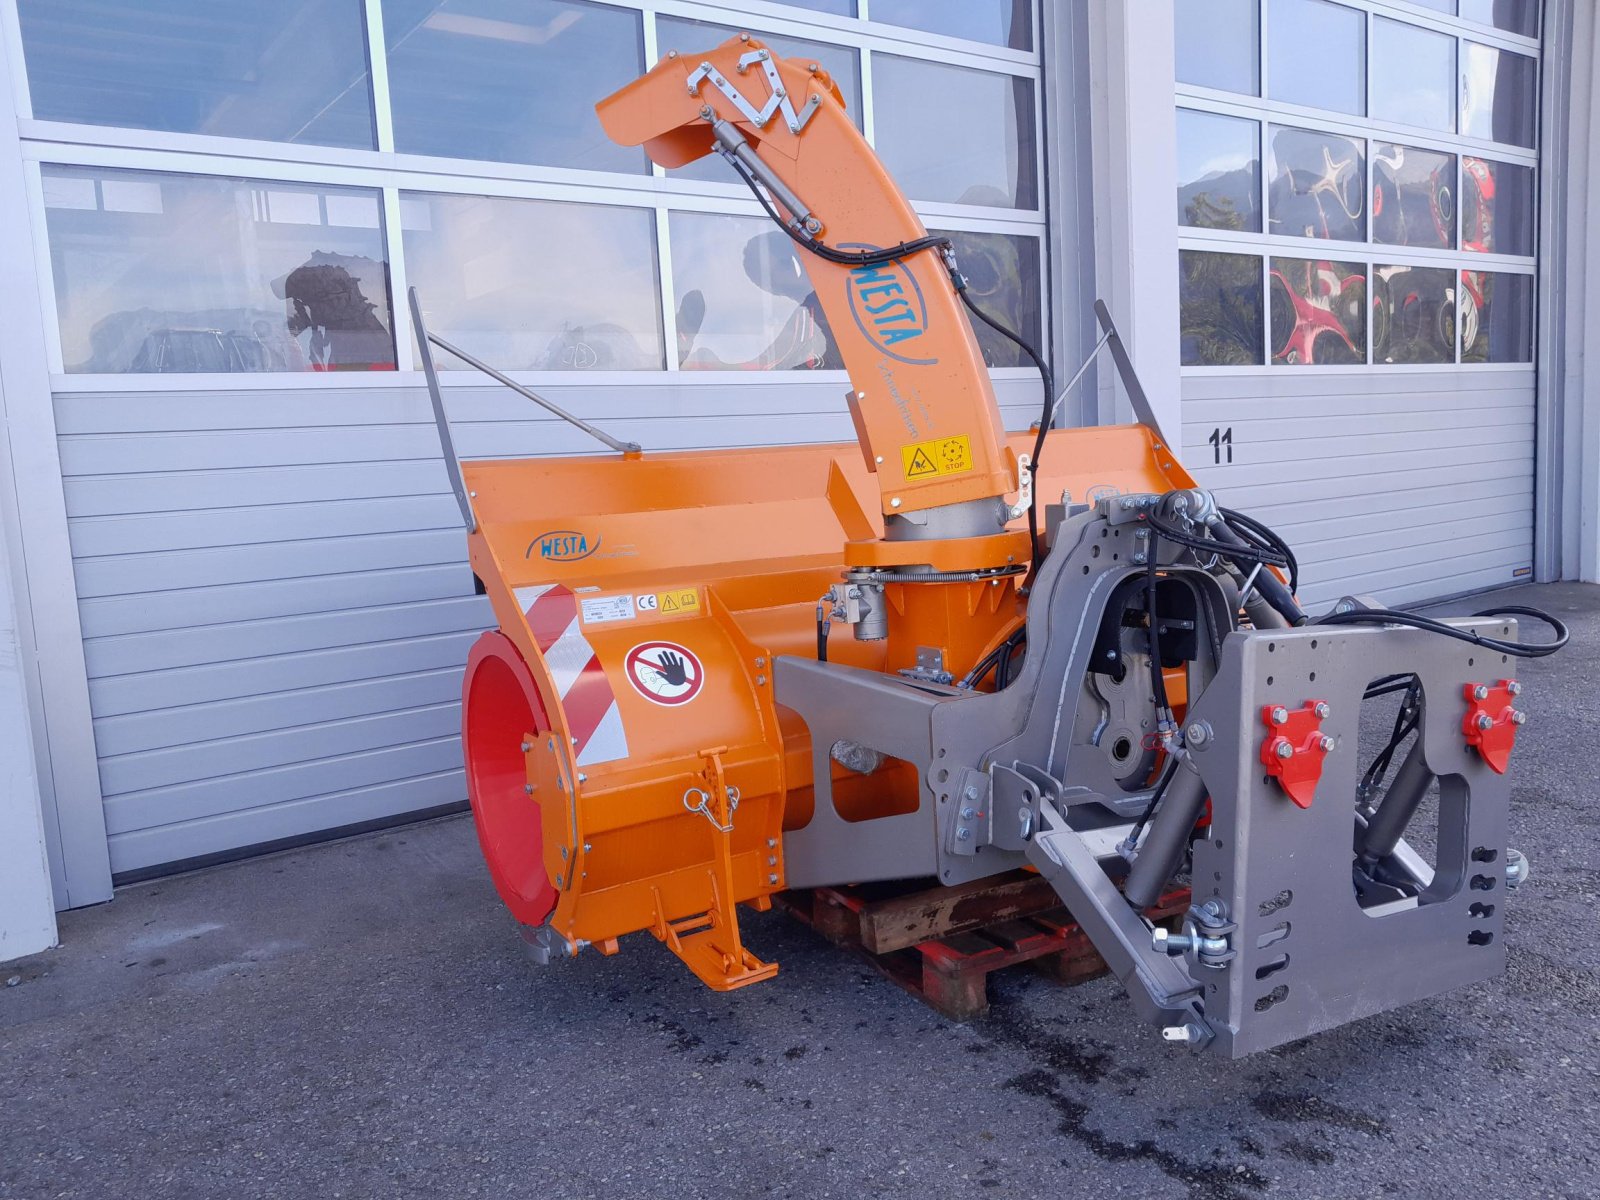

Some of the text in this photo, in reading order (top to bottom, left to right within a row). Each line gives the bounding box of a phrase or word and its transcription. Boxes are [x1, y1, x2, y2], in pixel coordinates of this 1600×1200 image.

[850, 262, 923, 345] WESTA
[1209, 427, 1232, 464] 11
[945, 462, 965, 471] STOP
[541, 536, 588, 557] WESTA
